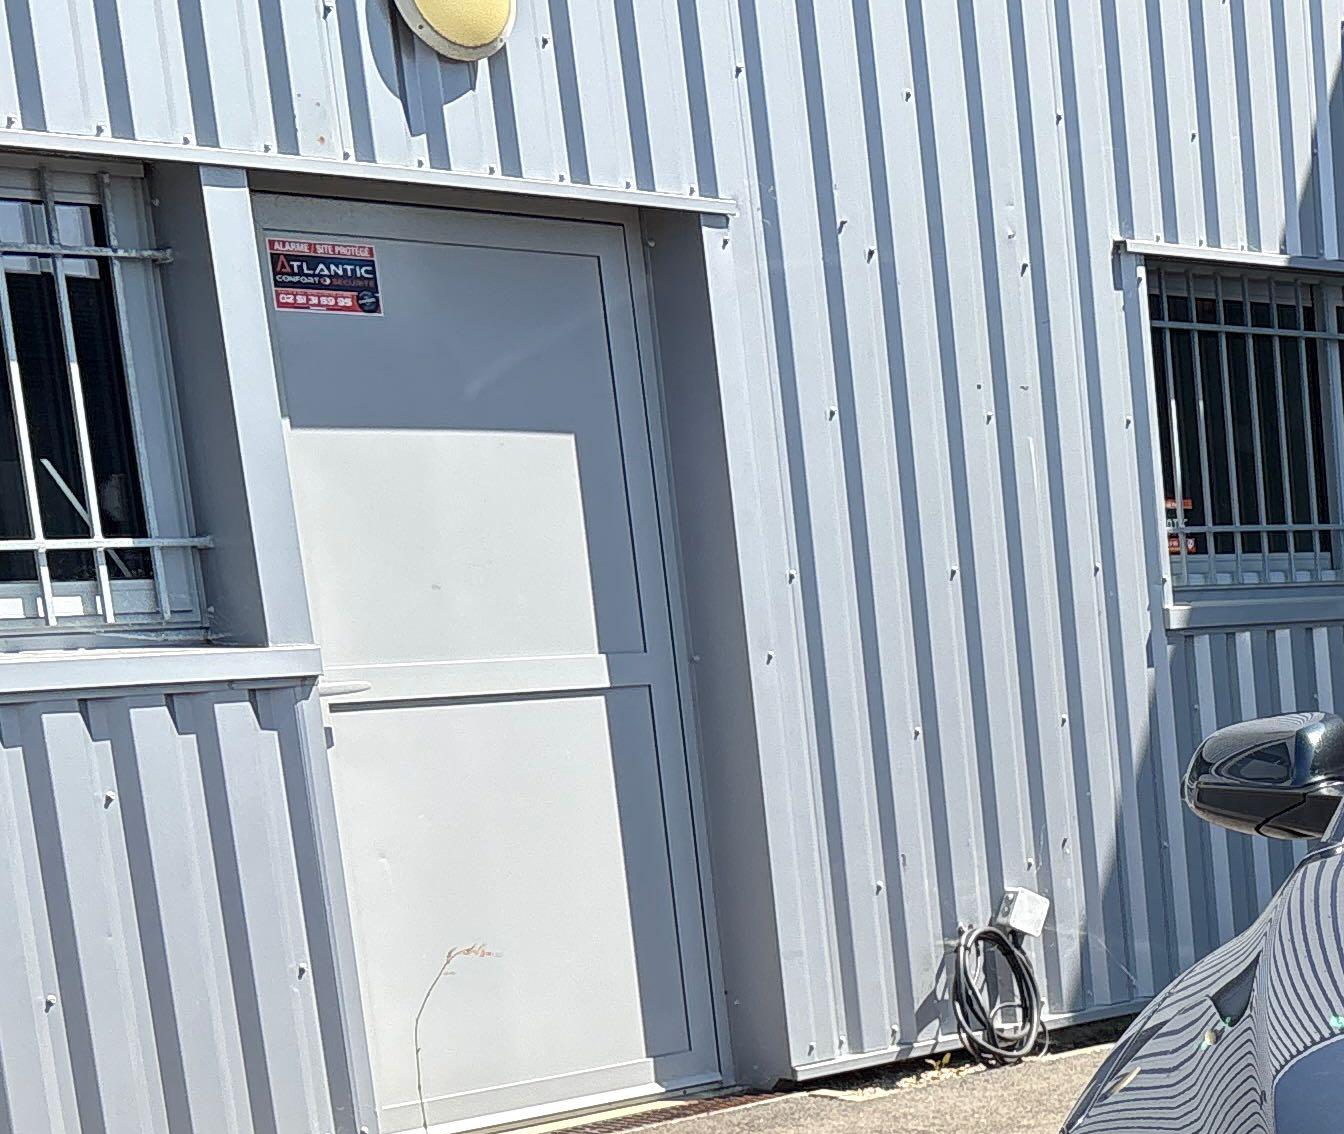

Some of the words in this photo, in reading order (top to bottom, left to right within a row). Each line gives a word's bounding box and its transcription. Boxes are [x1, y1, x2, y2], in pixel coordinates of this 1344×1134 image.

[274, 241, 309, 253] ALARME
[316, 244, 333, 255] SITE
[277, 255, 373, 278] ATLANTIC
[276, 275, 319, 284] CONFORT
